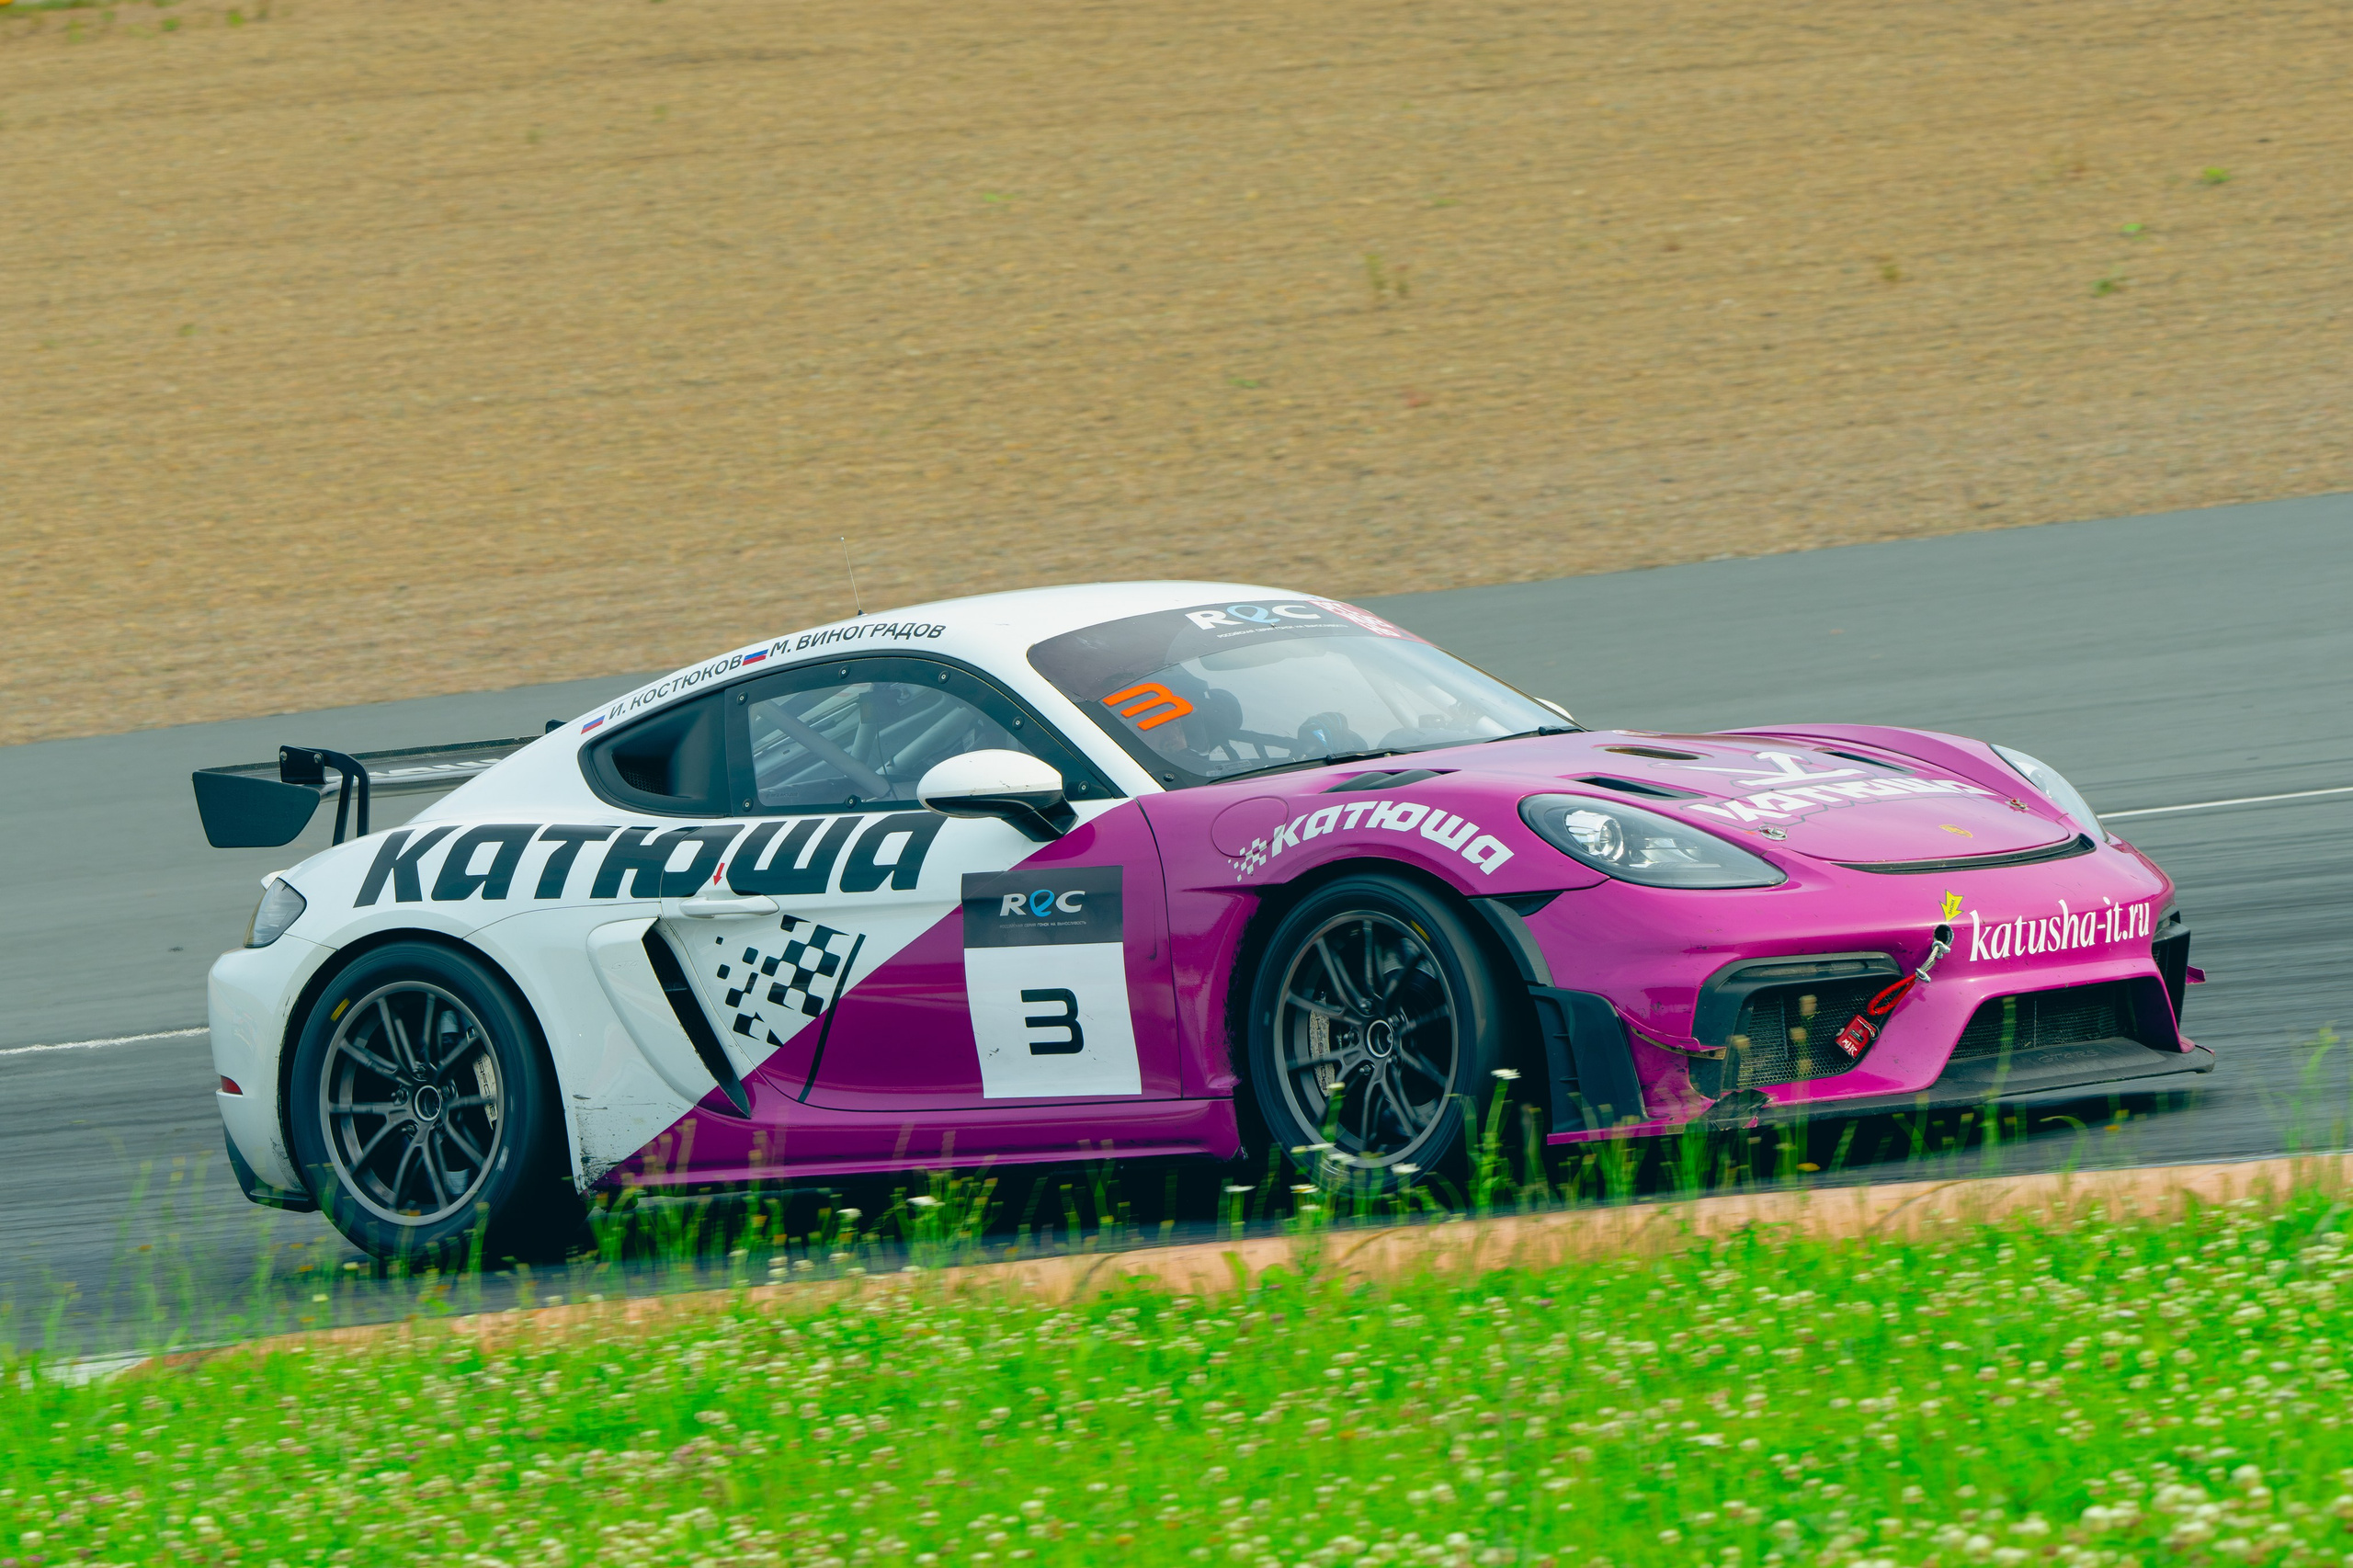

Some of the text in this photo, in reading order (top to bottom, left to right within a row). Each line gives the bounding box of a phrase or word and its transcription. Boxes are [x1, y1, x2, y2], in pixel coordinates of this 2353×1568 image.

[769, 622, 946, 657] М. ВИНОГРАДОВ
[608, 654, 743, 721] И. КОСТЮКОВ
[353, 812, 949, 909] КАТЮША
[1271, 801, 1515, 875] КАТЮША
[1969, 896, 2150, 962] katusha-it.ru
[1020, 987, 1085, 1055] 3
